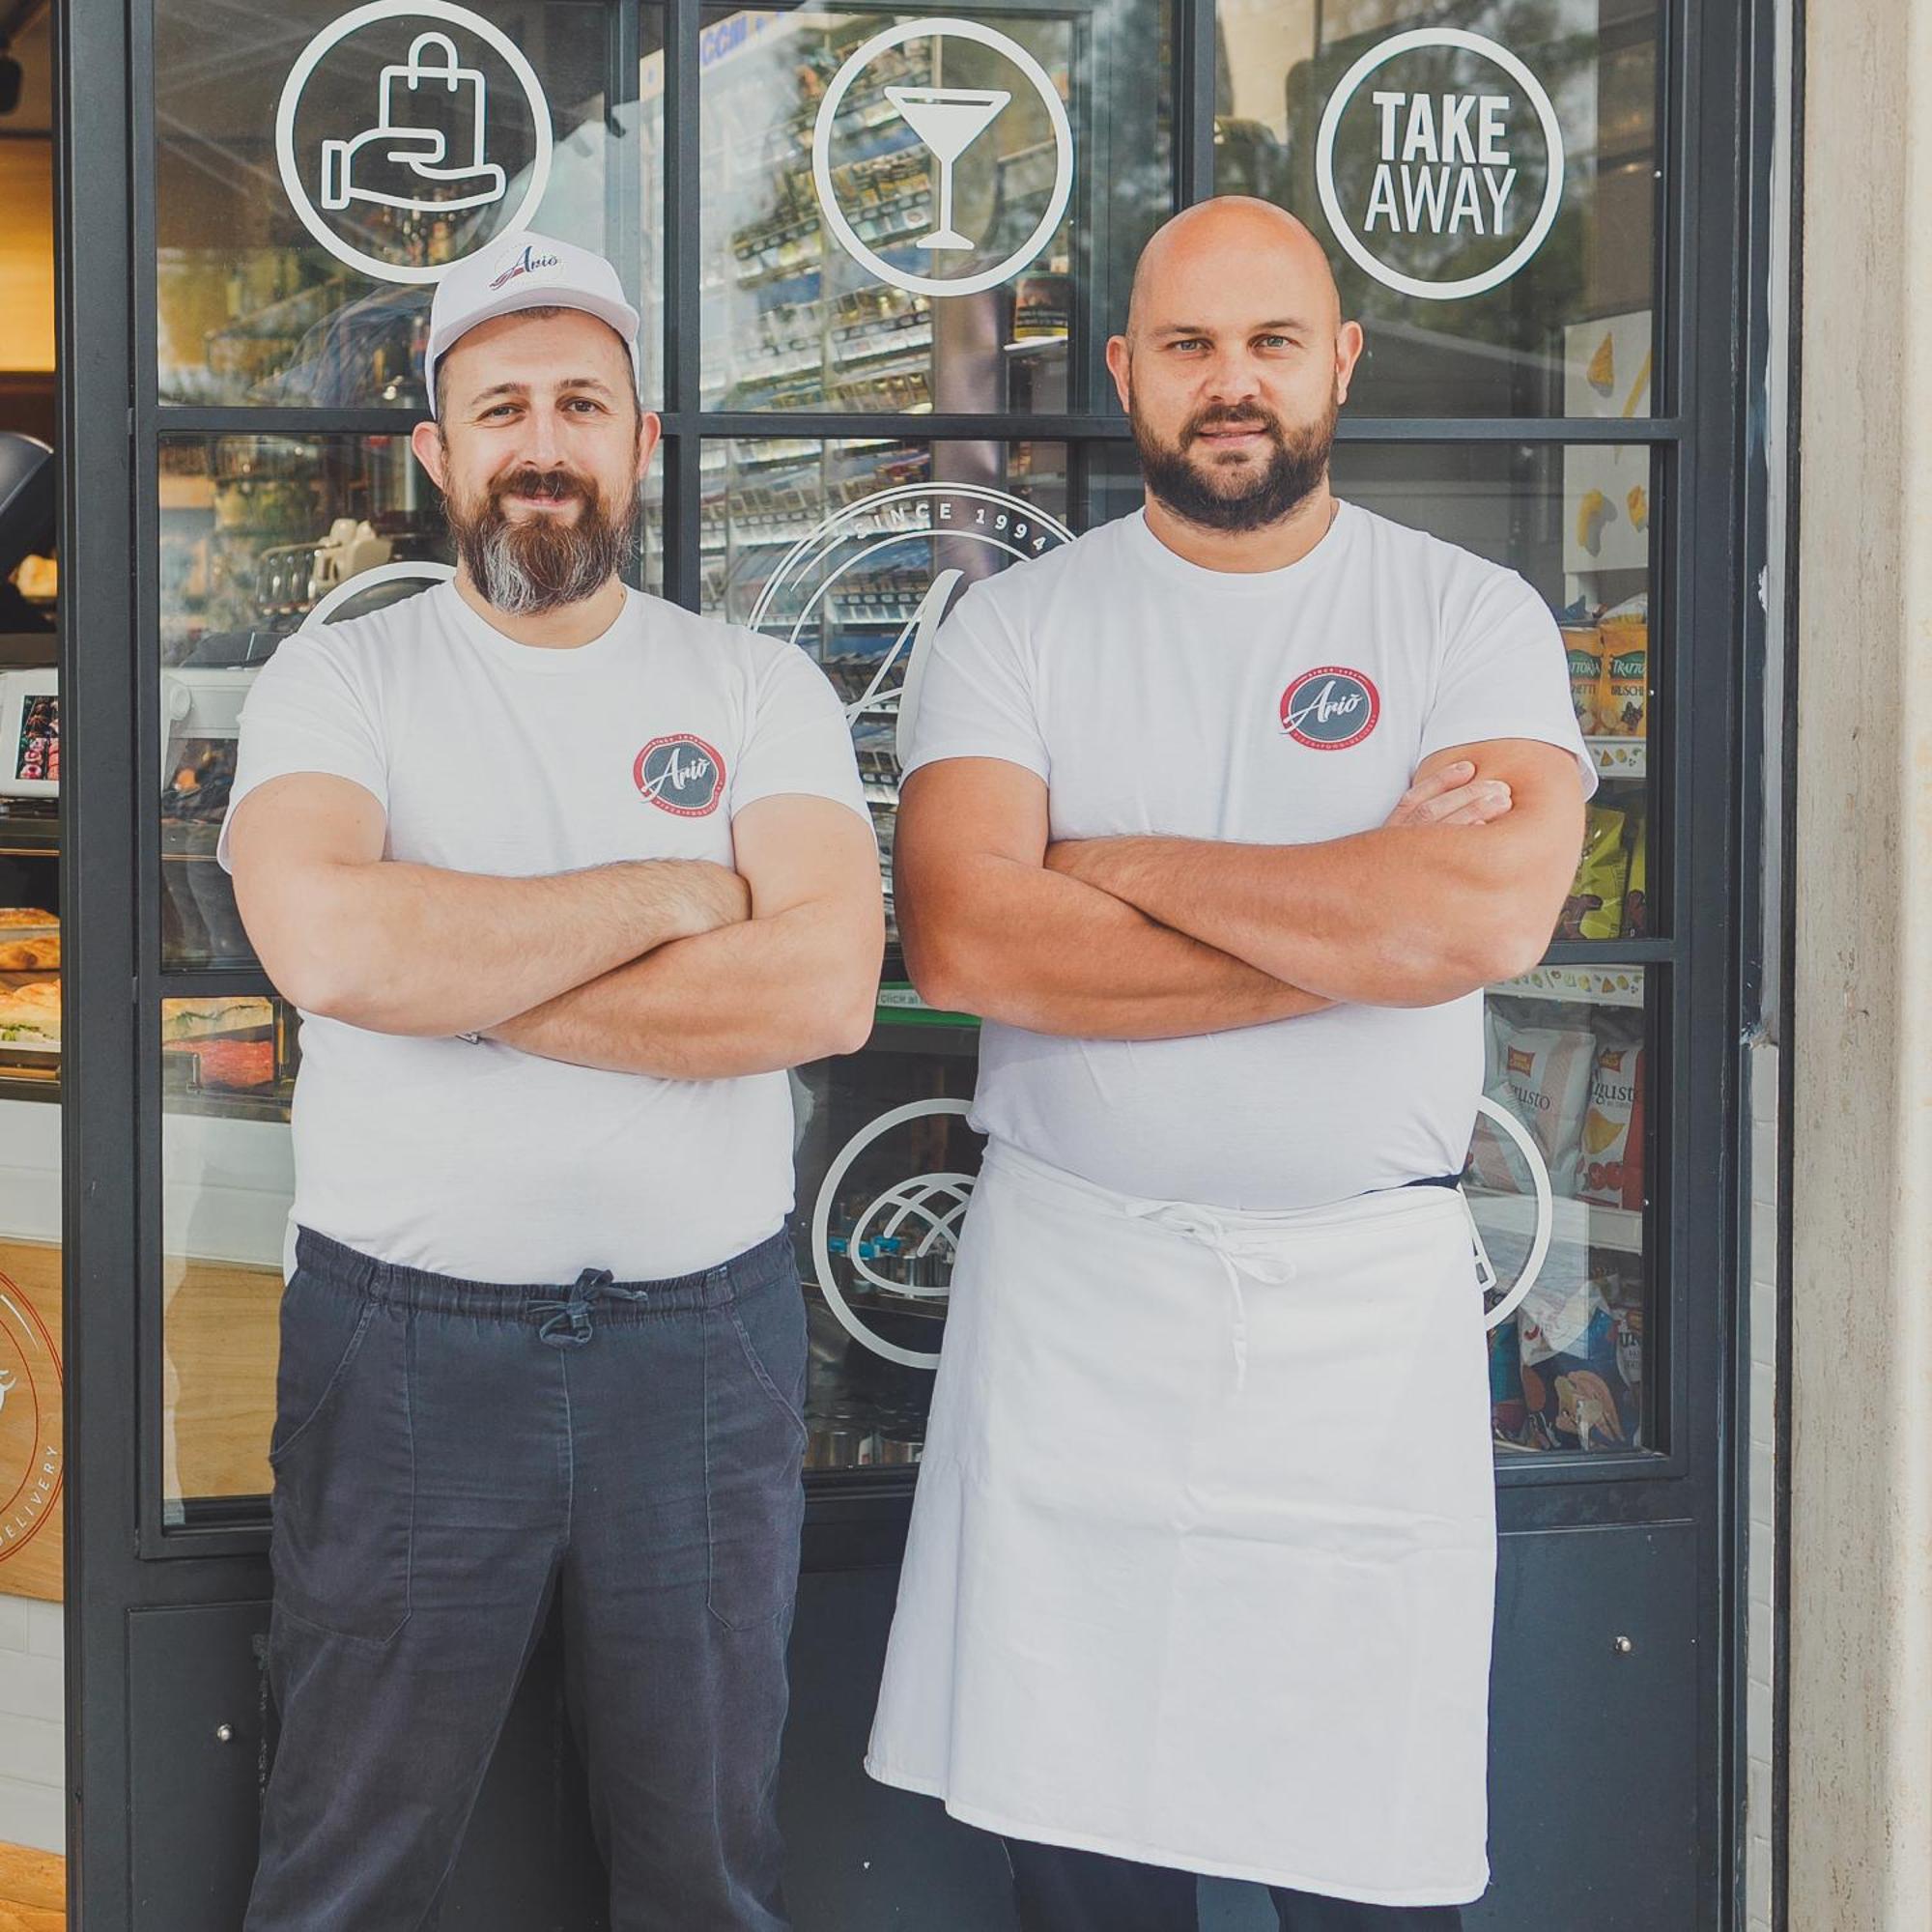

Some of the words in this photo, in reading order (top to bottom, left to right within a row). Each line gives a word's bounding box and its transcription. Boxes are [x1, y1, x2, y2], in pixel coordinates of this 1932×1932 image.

[1373, 91, 1511, 165] TAKE
[1364, 163, 1517, 235] AWAY
[854, 502, 952, 539] SINCE
[976, 508, 1047, 551] 1994
